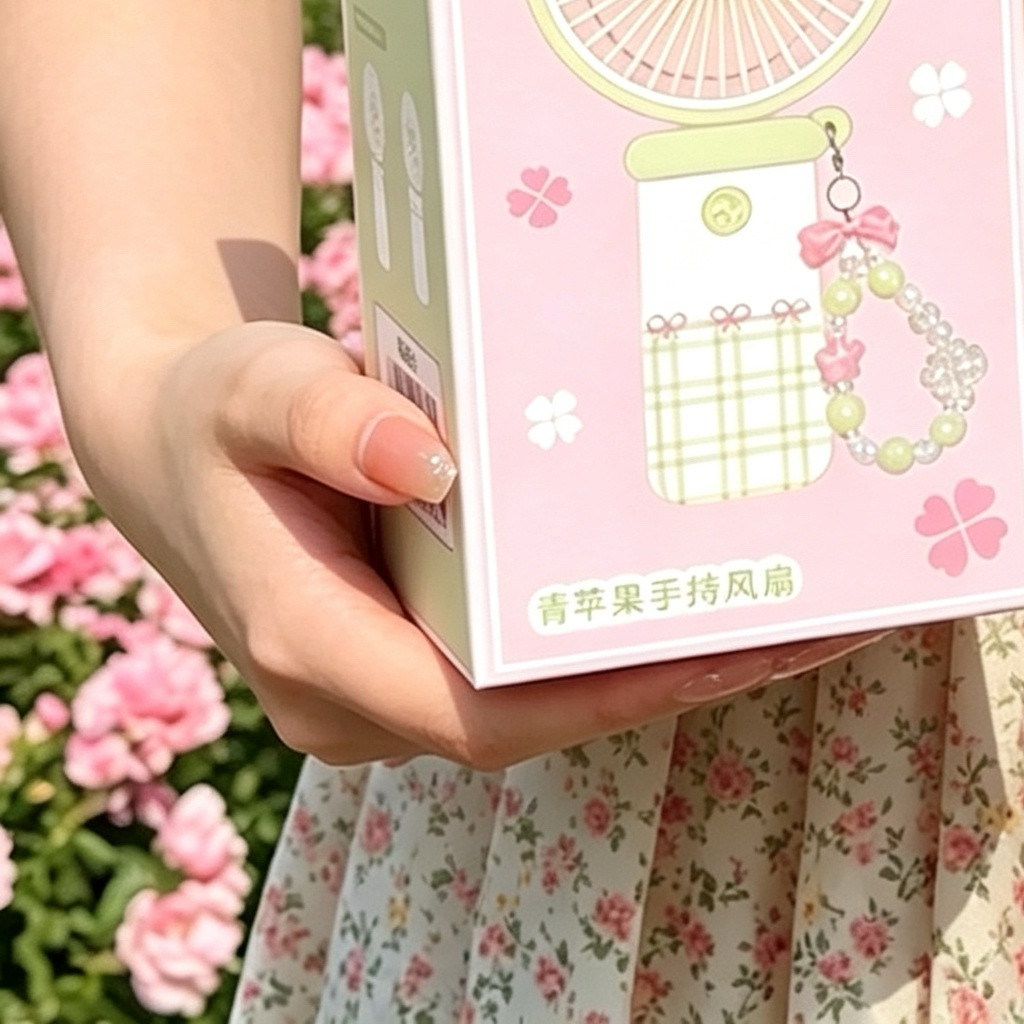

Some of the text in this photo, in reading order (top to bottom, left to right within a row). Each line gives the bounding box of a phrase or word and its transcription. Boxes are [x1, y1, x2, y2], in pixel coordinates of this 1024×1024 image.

[537, 563, 794, 626] 青苹果手持风扇
